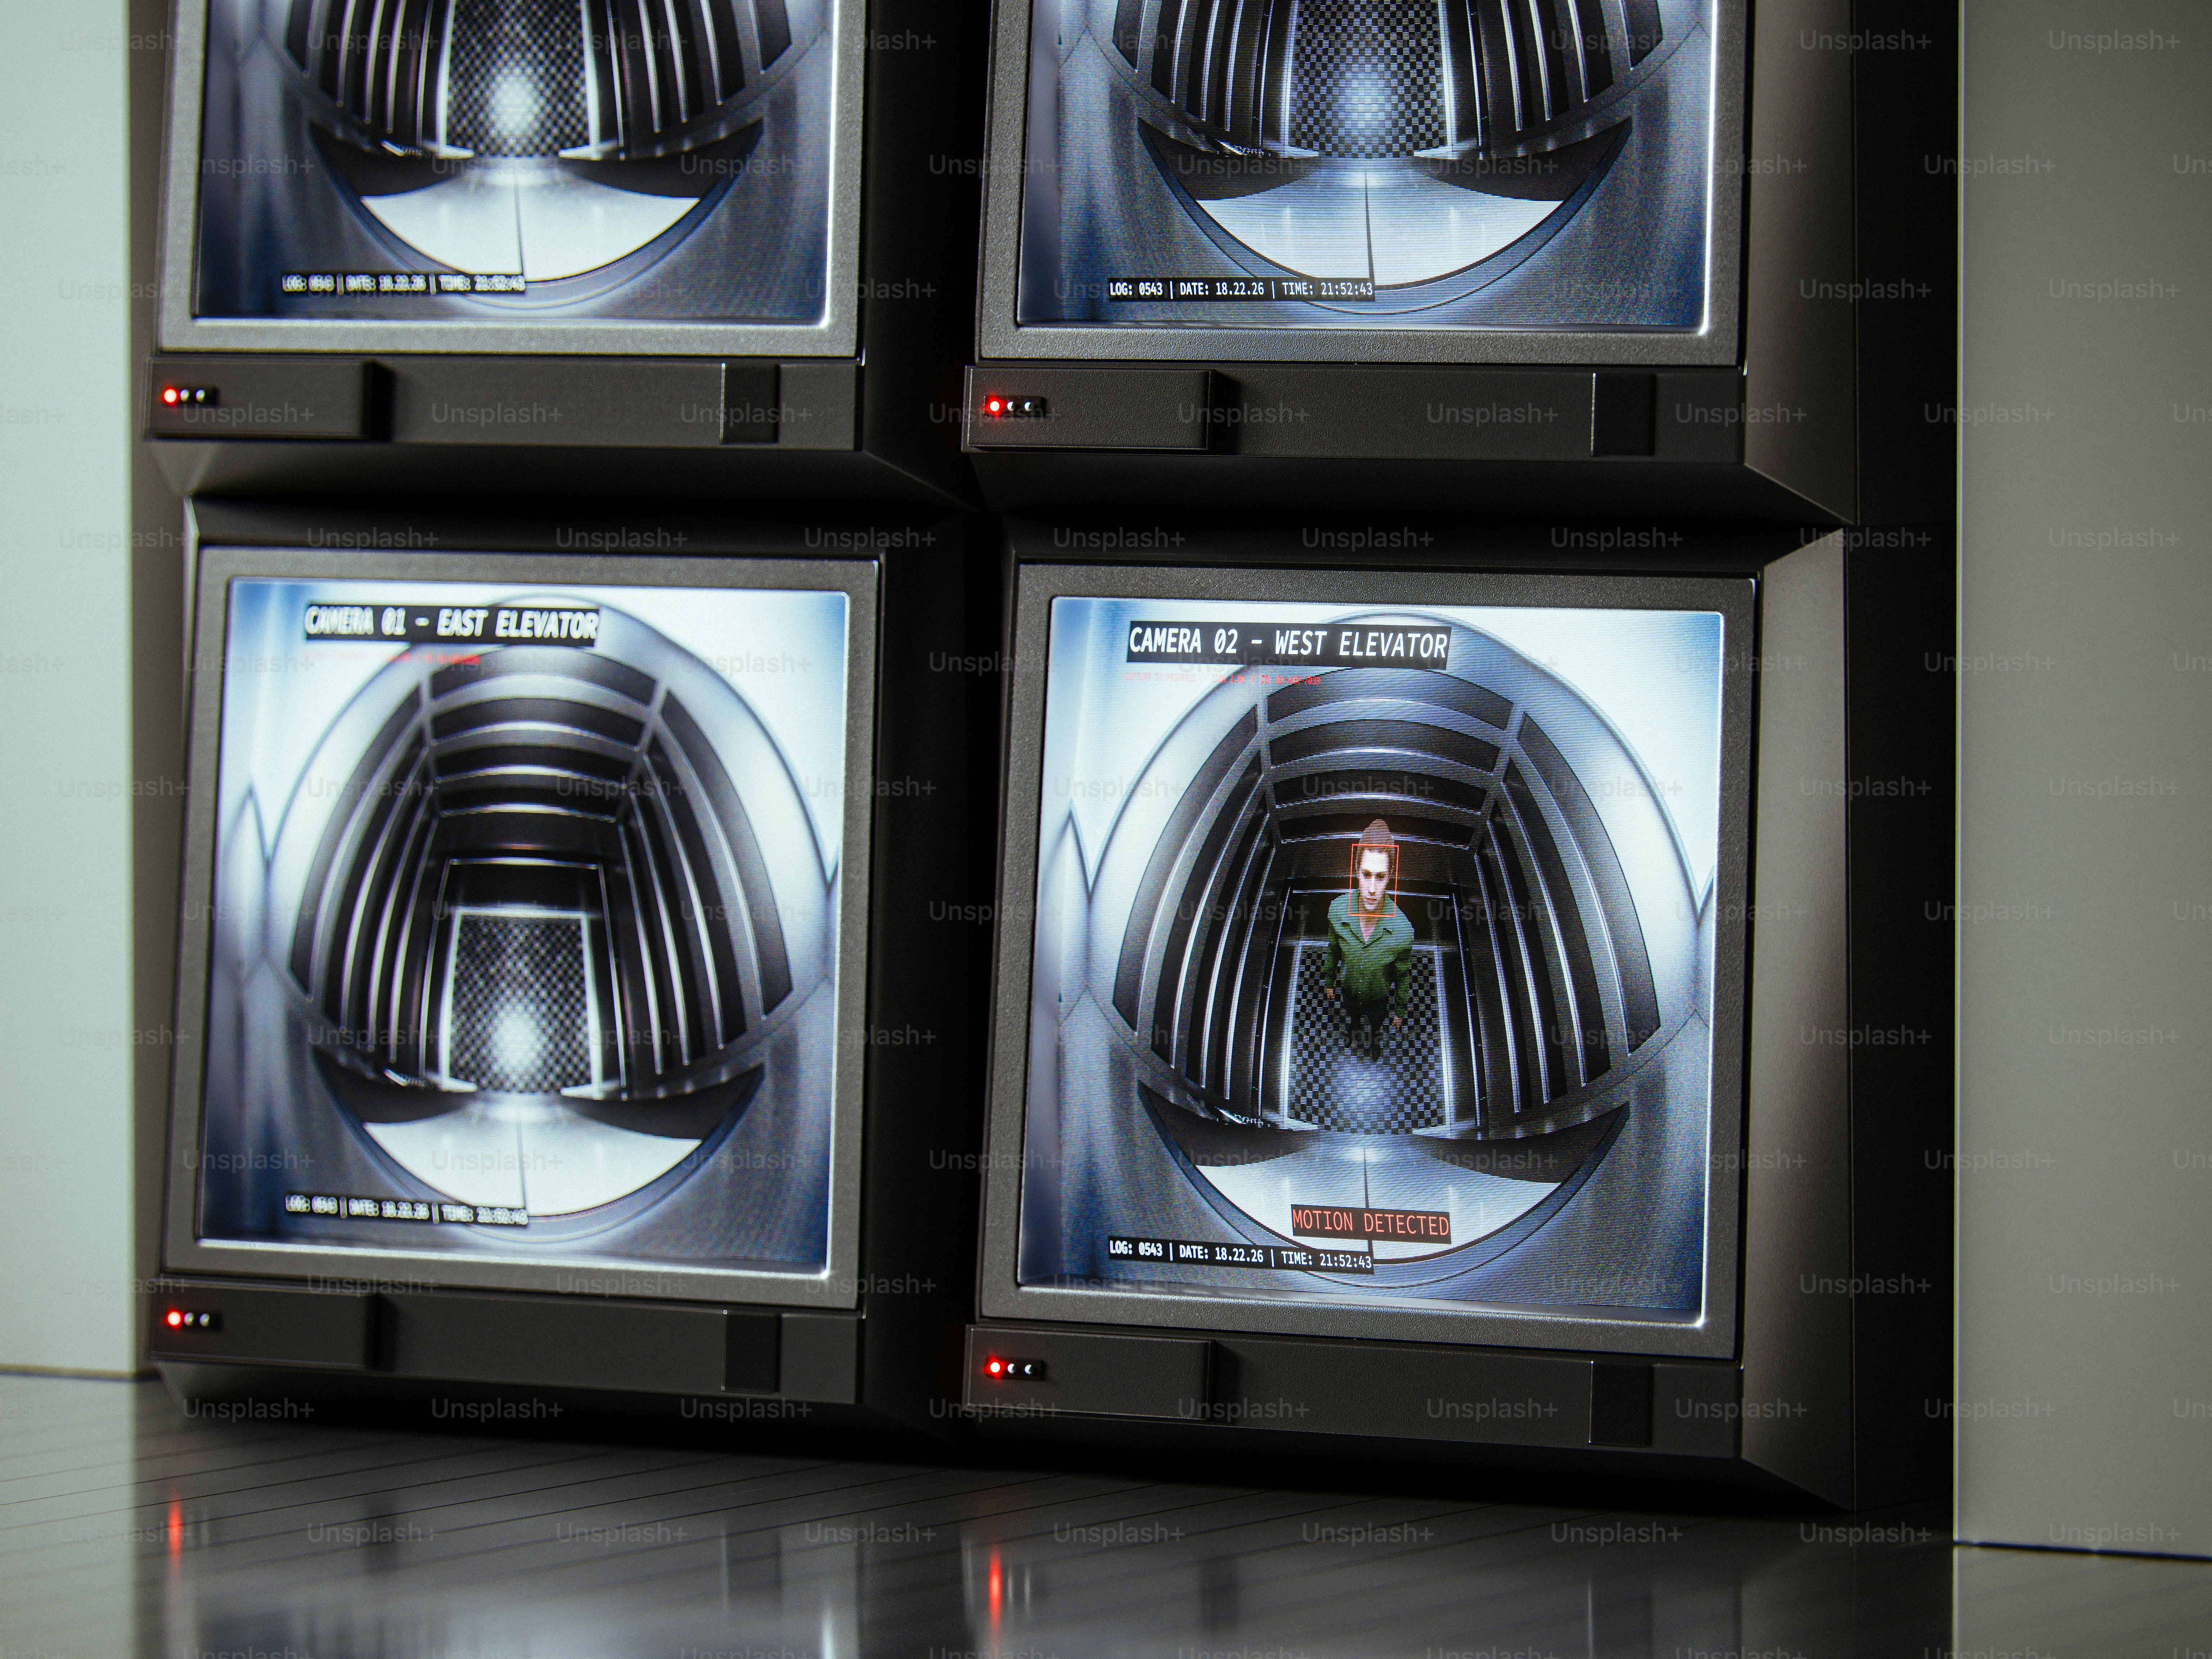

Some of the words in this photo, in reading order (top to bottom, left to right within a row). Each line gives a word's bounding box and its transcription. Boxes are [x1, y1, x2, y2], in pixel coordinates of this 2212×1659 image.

[1110, 282, 1132, 296] LOG:
[1139, 282, 1163, 296] 0543
[1180, 282, 1209, 296] DATE:
[1216, 282, 1264, 296] 18.22.26
[1282, 282, 1313, 296] TIME:
[1321, 282, 1373, 296] 21:52:43
[305, 605, 374, 635] CAMERA
[382, 607, 406, 635] 01
[437, 608, 488, 637] EAST
[495, 610, 599, 640] ELEVATOR
[1130, 627, 1202, 654] CAMERA
[1214, 628, 1238, 654] 02
[1275, 630, 1327, 656] WEST
[1339, 632, 1448, 658] ELEVATOR
[1292, 1209, 1353, 1231] MOTION
[1364, 1213, 1449, 1236] DETECTED
[1109, 1241, 1132, 1255] LOG:
[1138, 1242, 1163, 1256] 0543
[1179, 1245, 1209, 1259] DATE:
[1215, 1247, 1264, 1263] 18.22.26
[1281, 1251, 1313, 1266] TIME:
[1319, 1253, 1372, 1269] 21:52:43
